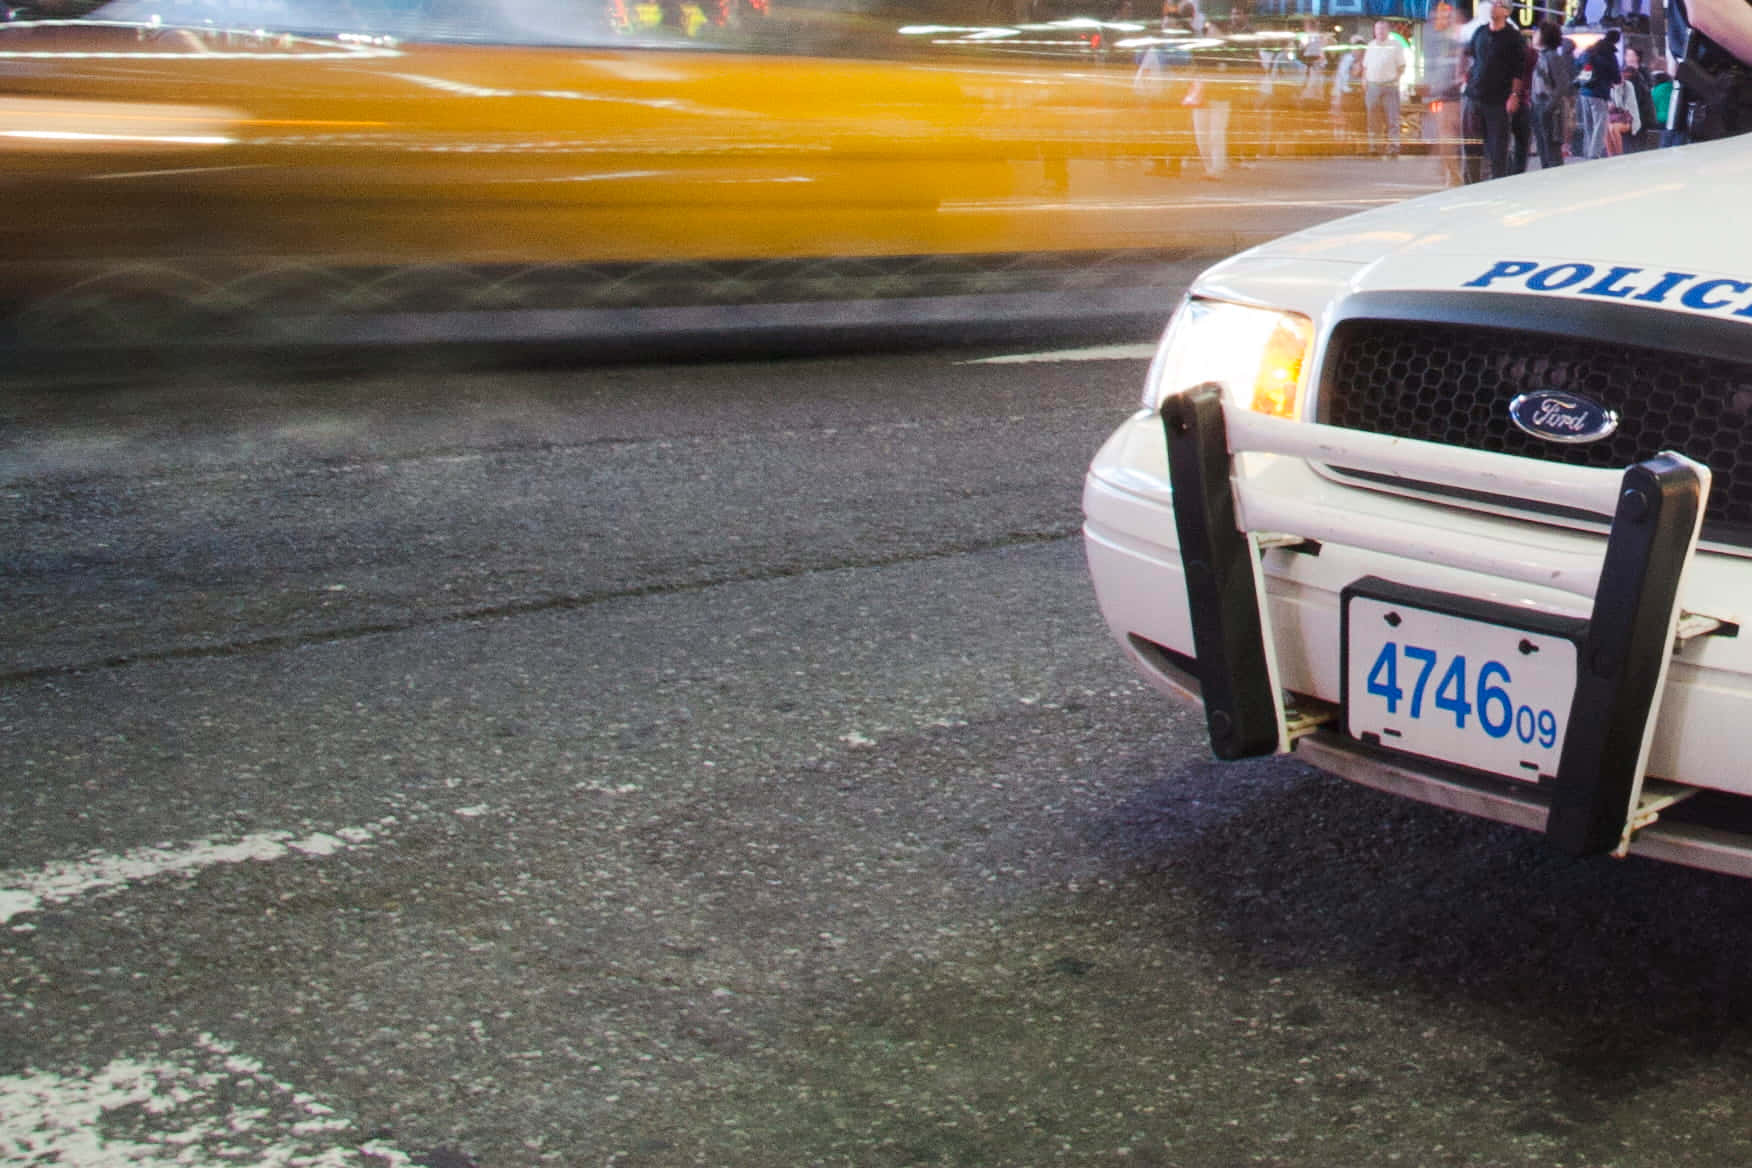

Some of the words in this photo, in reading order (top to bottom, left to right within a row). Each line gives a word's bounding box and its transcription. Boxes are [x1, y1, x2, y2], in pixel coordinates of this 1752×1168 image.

[1530, 398, 1587, 433] Ford
[1366, 641, 1514, 739] 4746
[1515, 704, 1558, 750] 09
